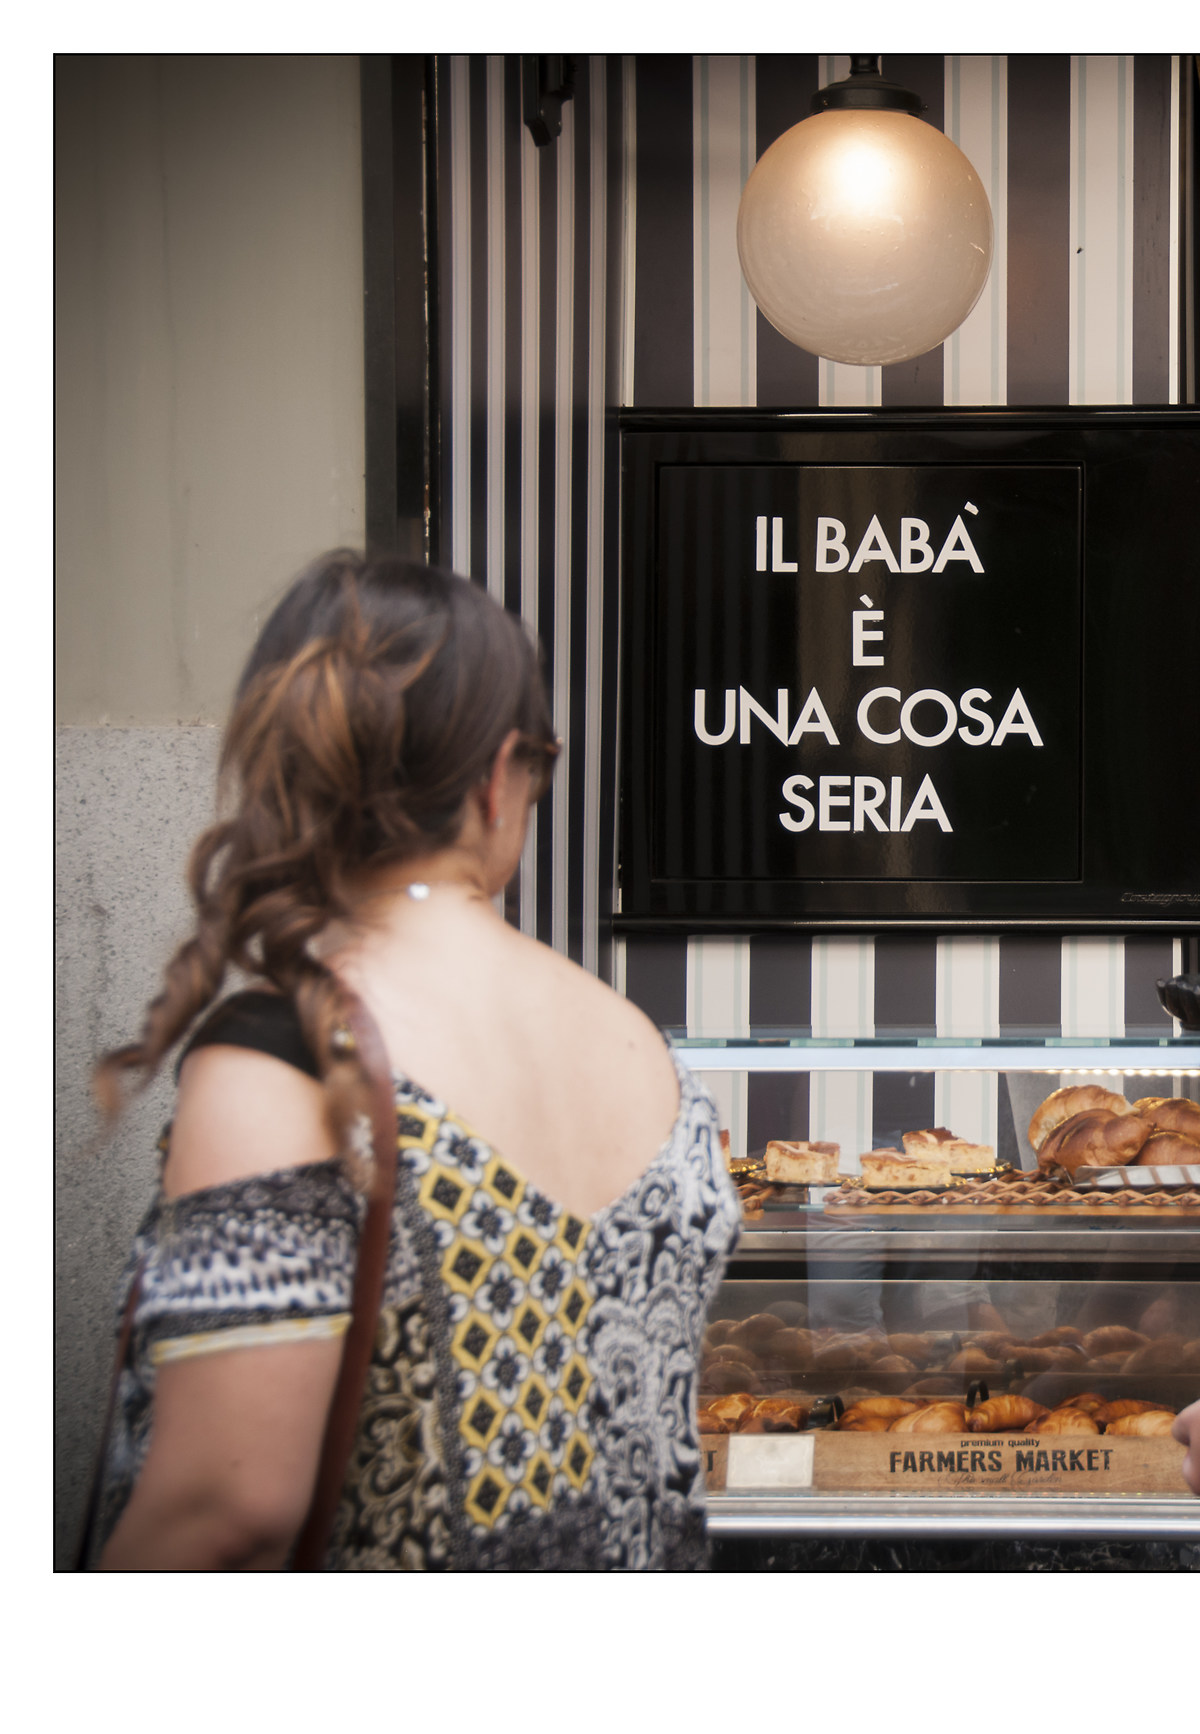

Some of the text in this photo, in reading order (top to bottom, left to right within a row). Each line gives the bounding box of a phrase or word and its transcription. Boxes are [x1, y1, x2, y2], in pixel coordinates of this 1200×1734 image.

[756, 502, 984, 573] IL BABÀ
[853, 594, 884, 666] È
[694, 686, 1043, 747] UNA COSA
[779, 774, 953, 833] SERIA
[889, 1449, 1114, 1473] FARMERS MARKET
[960, 1438, 1040, 1448] premium quality
